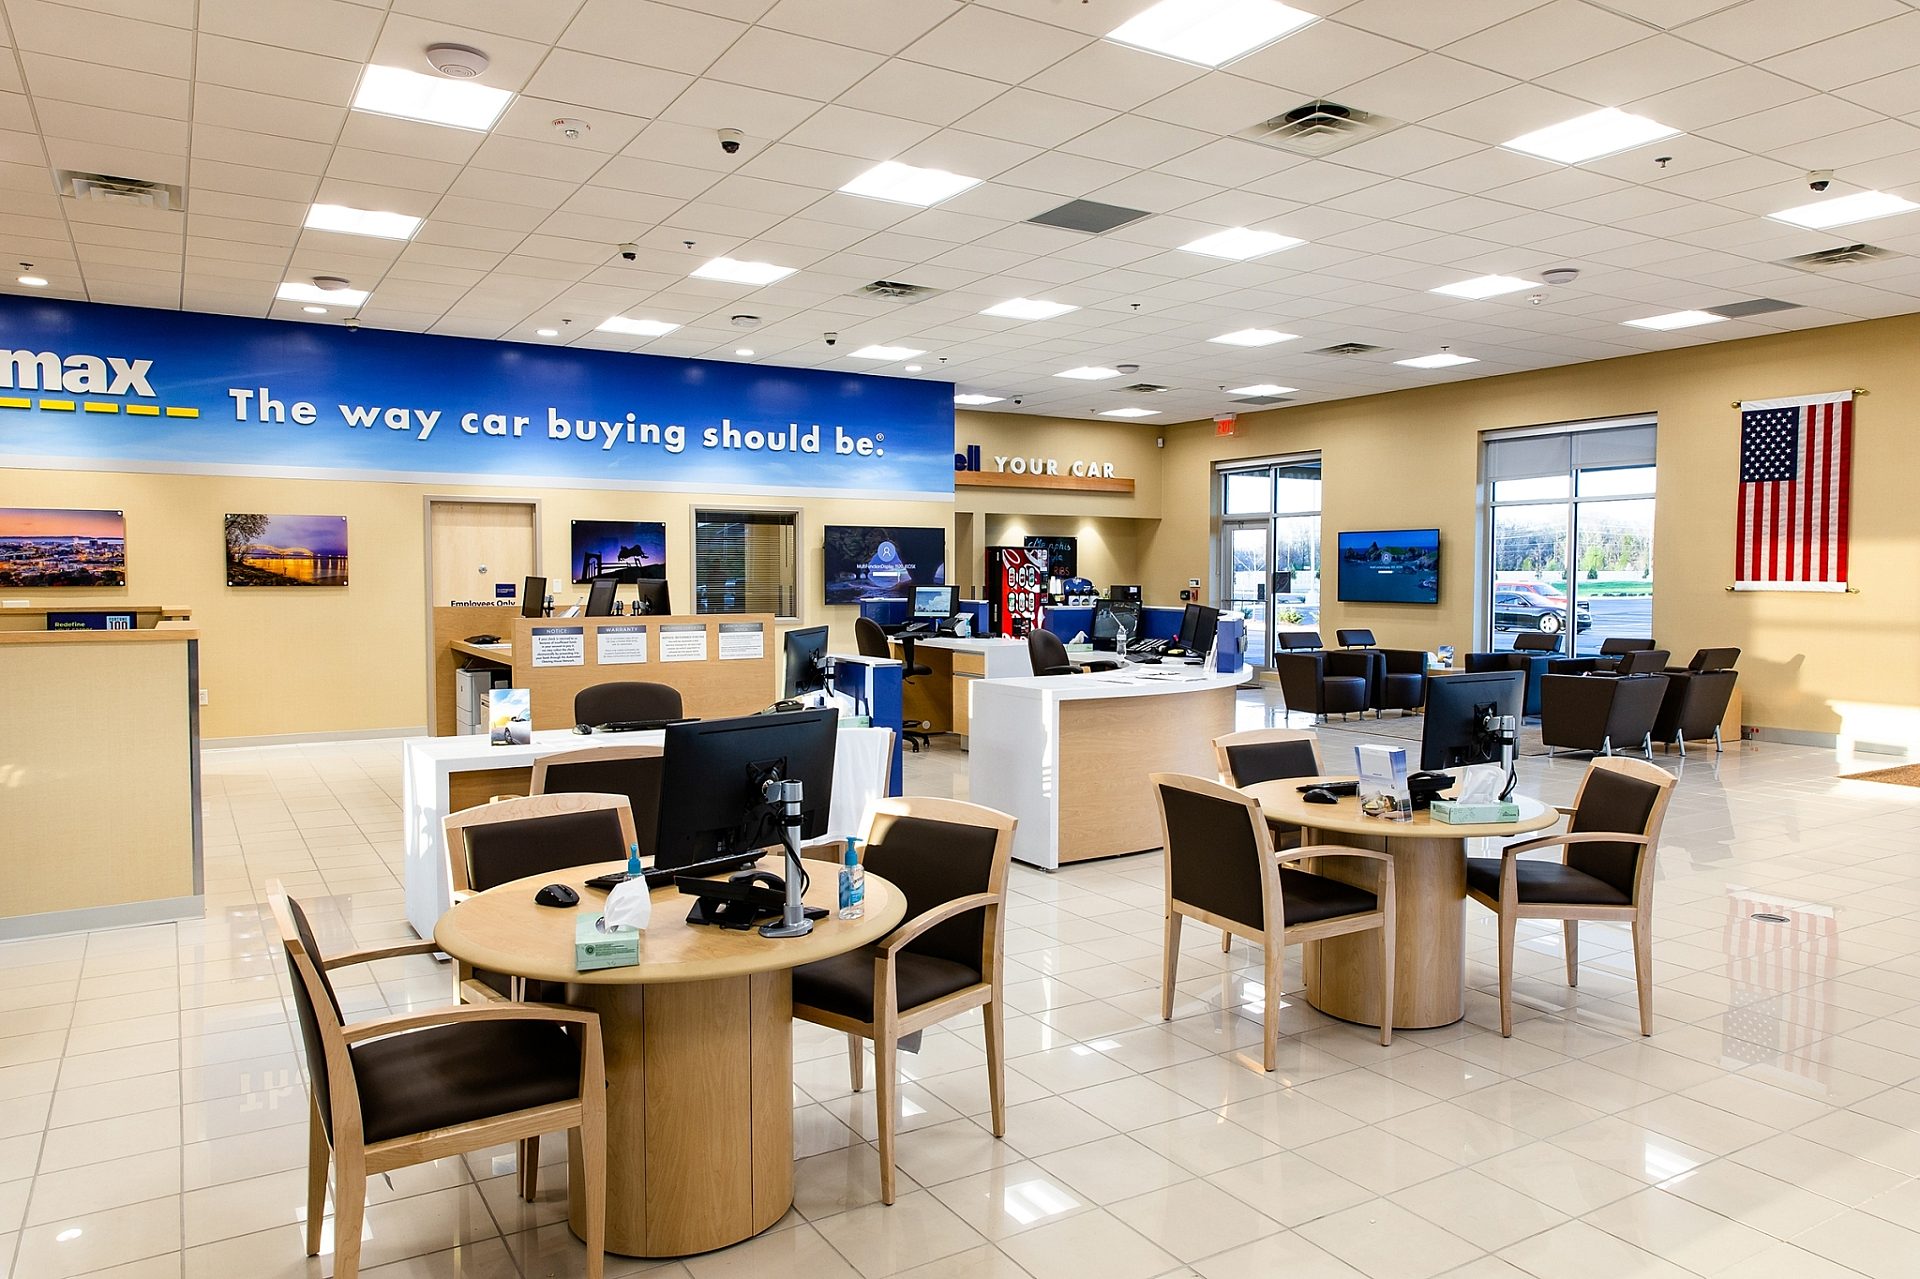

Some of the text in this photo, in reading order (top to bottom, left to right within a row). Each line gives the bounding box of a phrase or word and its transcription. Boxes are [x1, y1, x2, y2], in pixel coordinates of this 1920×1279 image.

[0, 349, 157, 397] max
[228, 387, 318, 425] The
[338, 404, 442, 440] way
[461, 412, 530, 437] car
[547, 407, 686, 454] buying
[702, 419, 820, 454] should
[994, 456, 1059, 476] YOUR
[1071, 460, 1115, 478] CAR
